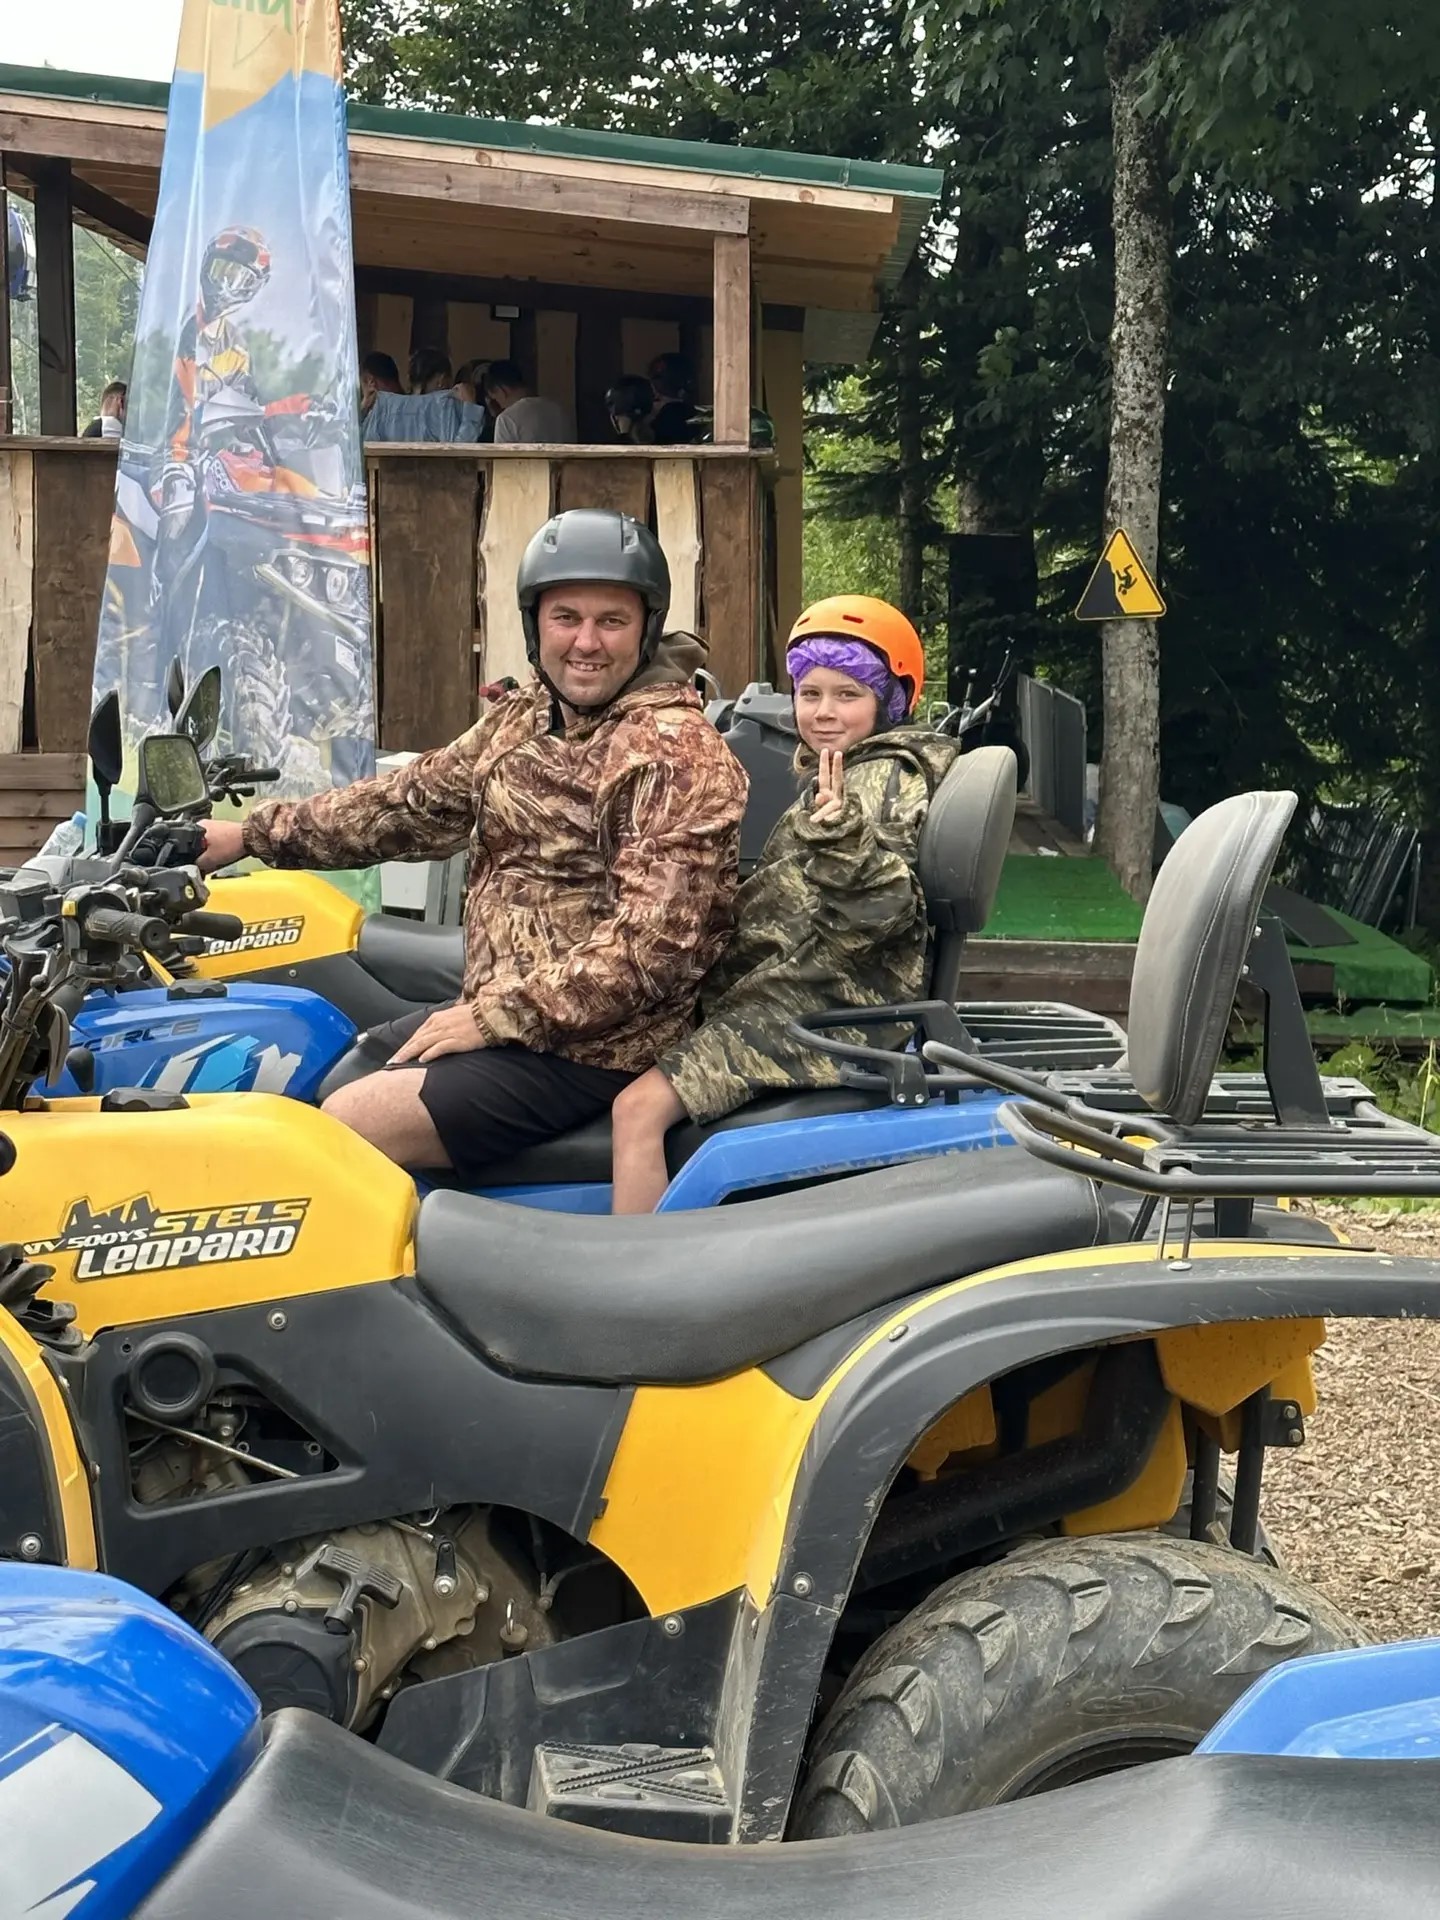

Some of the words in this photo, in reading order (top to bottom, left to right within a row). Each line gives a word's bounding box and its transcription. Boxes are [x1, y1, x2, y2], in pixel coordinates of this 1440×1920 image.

[242, 918, 303, 935] TELS
[149, 1200, 308, 1236] STELS
[66, 1228, 149, 1249] 500YS
